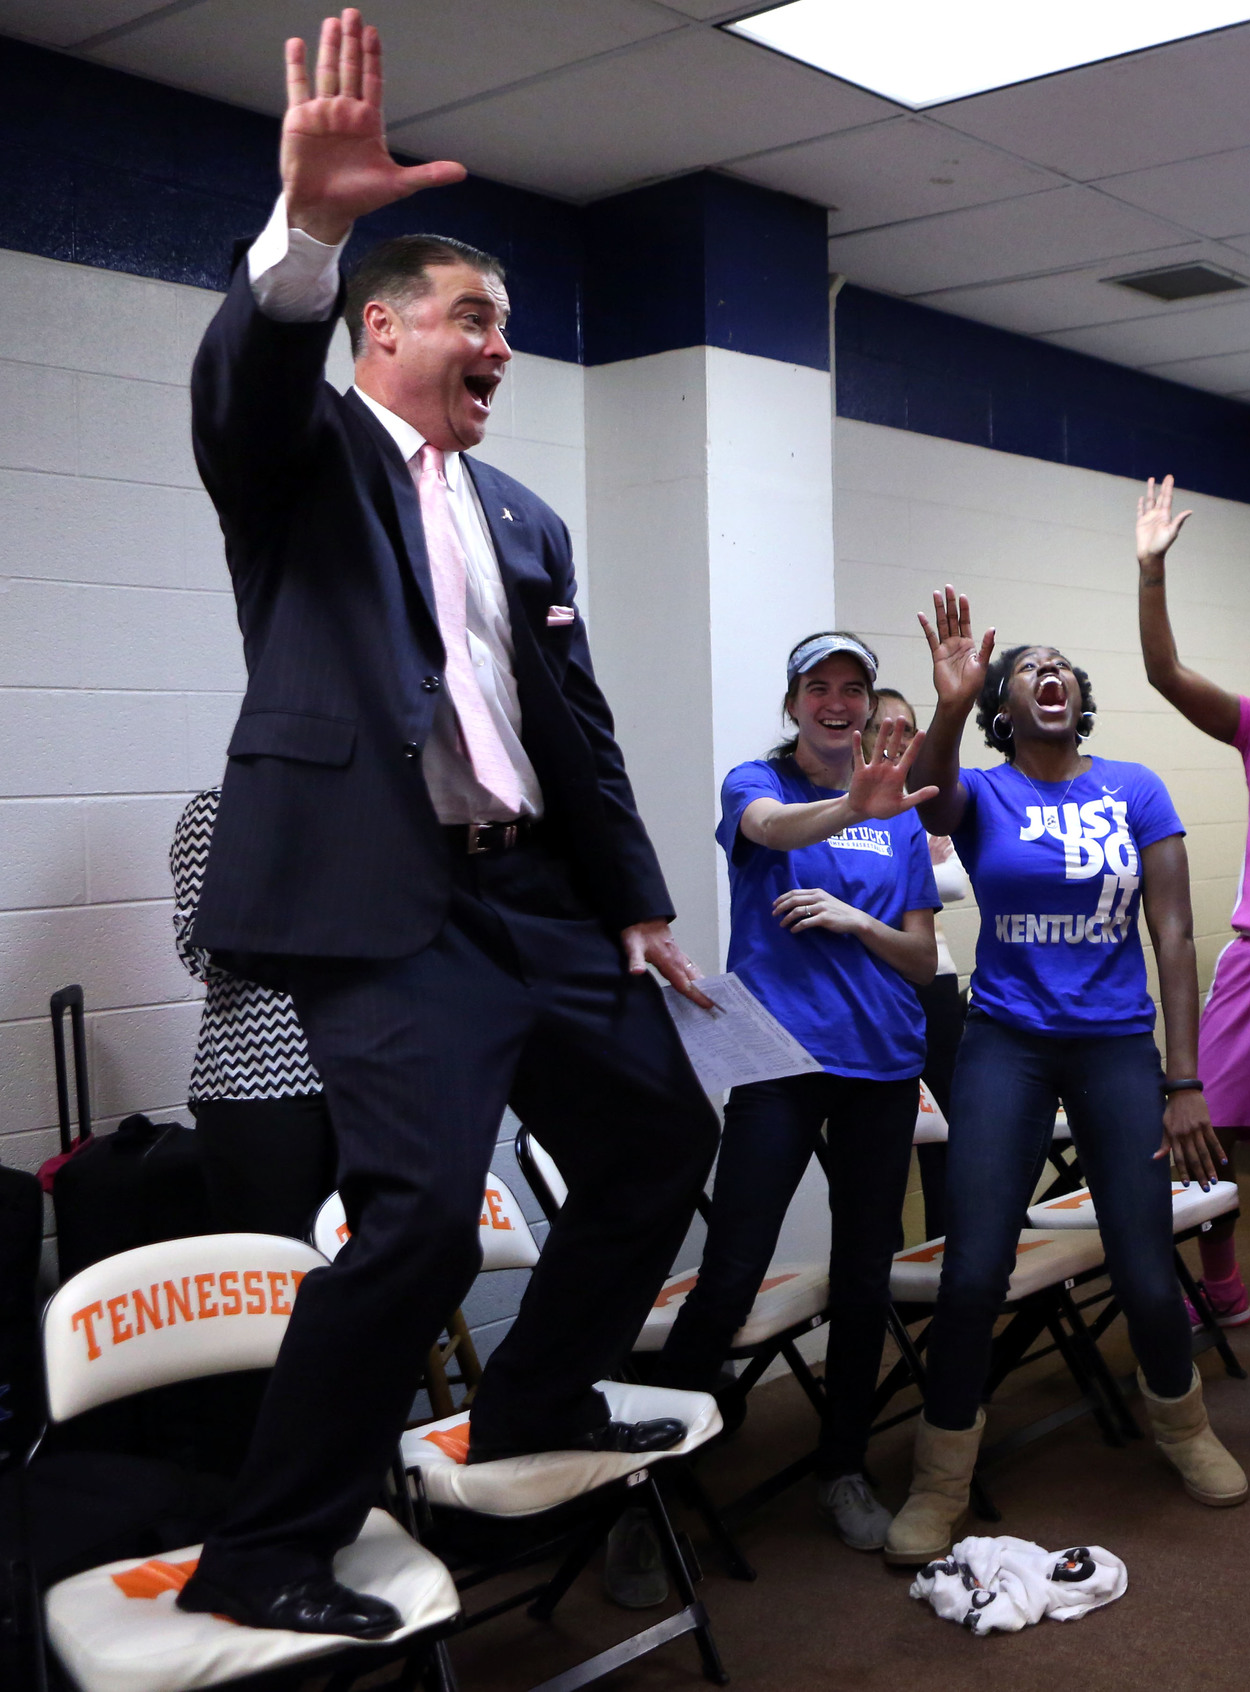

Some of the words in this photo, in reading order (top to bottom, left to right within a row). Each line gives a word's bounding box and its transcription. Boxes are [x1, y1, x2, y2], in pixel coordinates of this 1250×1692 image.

[831, 827, 891, 846] NTUCKY
[1020, 795, 1129, 841] JUST
[1064, 831, 1138, 879] DO
[1095, 874, 1139, 918] IT
[995, 914, 1131, 944] KENTUCKY
[71, 1270, 308, 1362] TENNESSE
